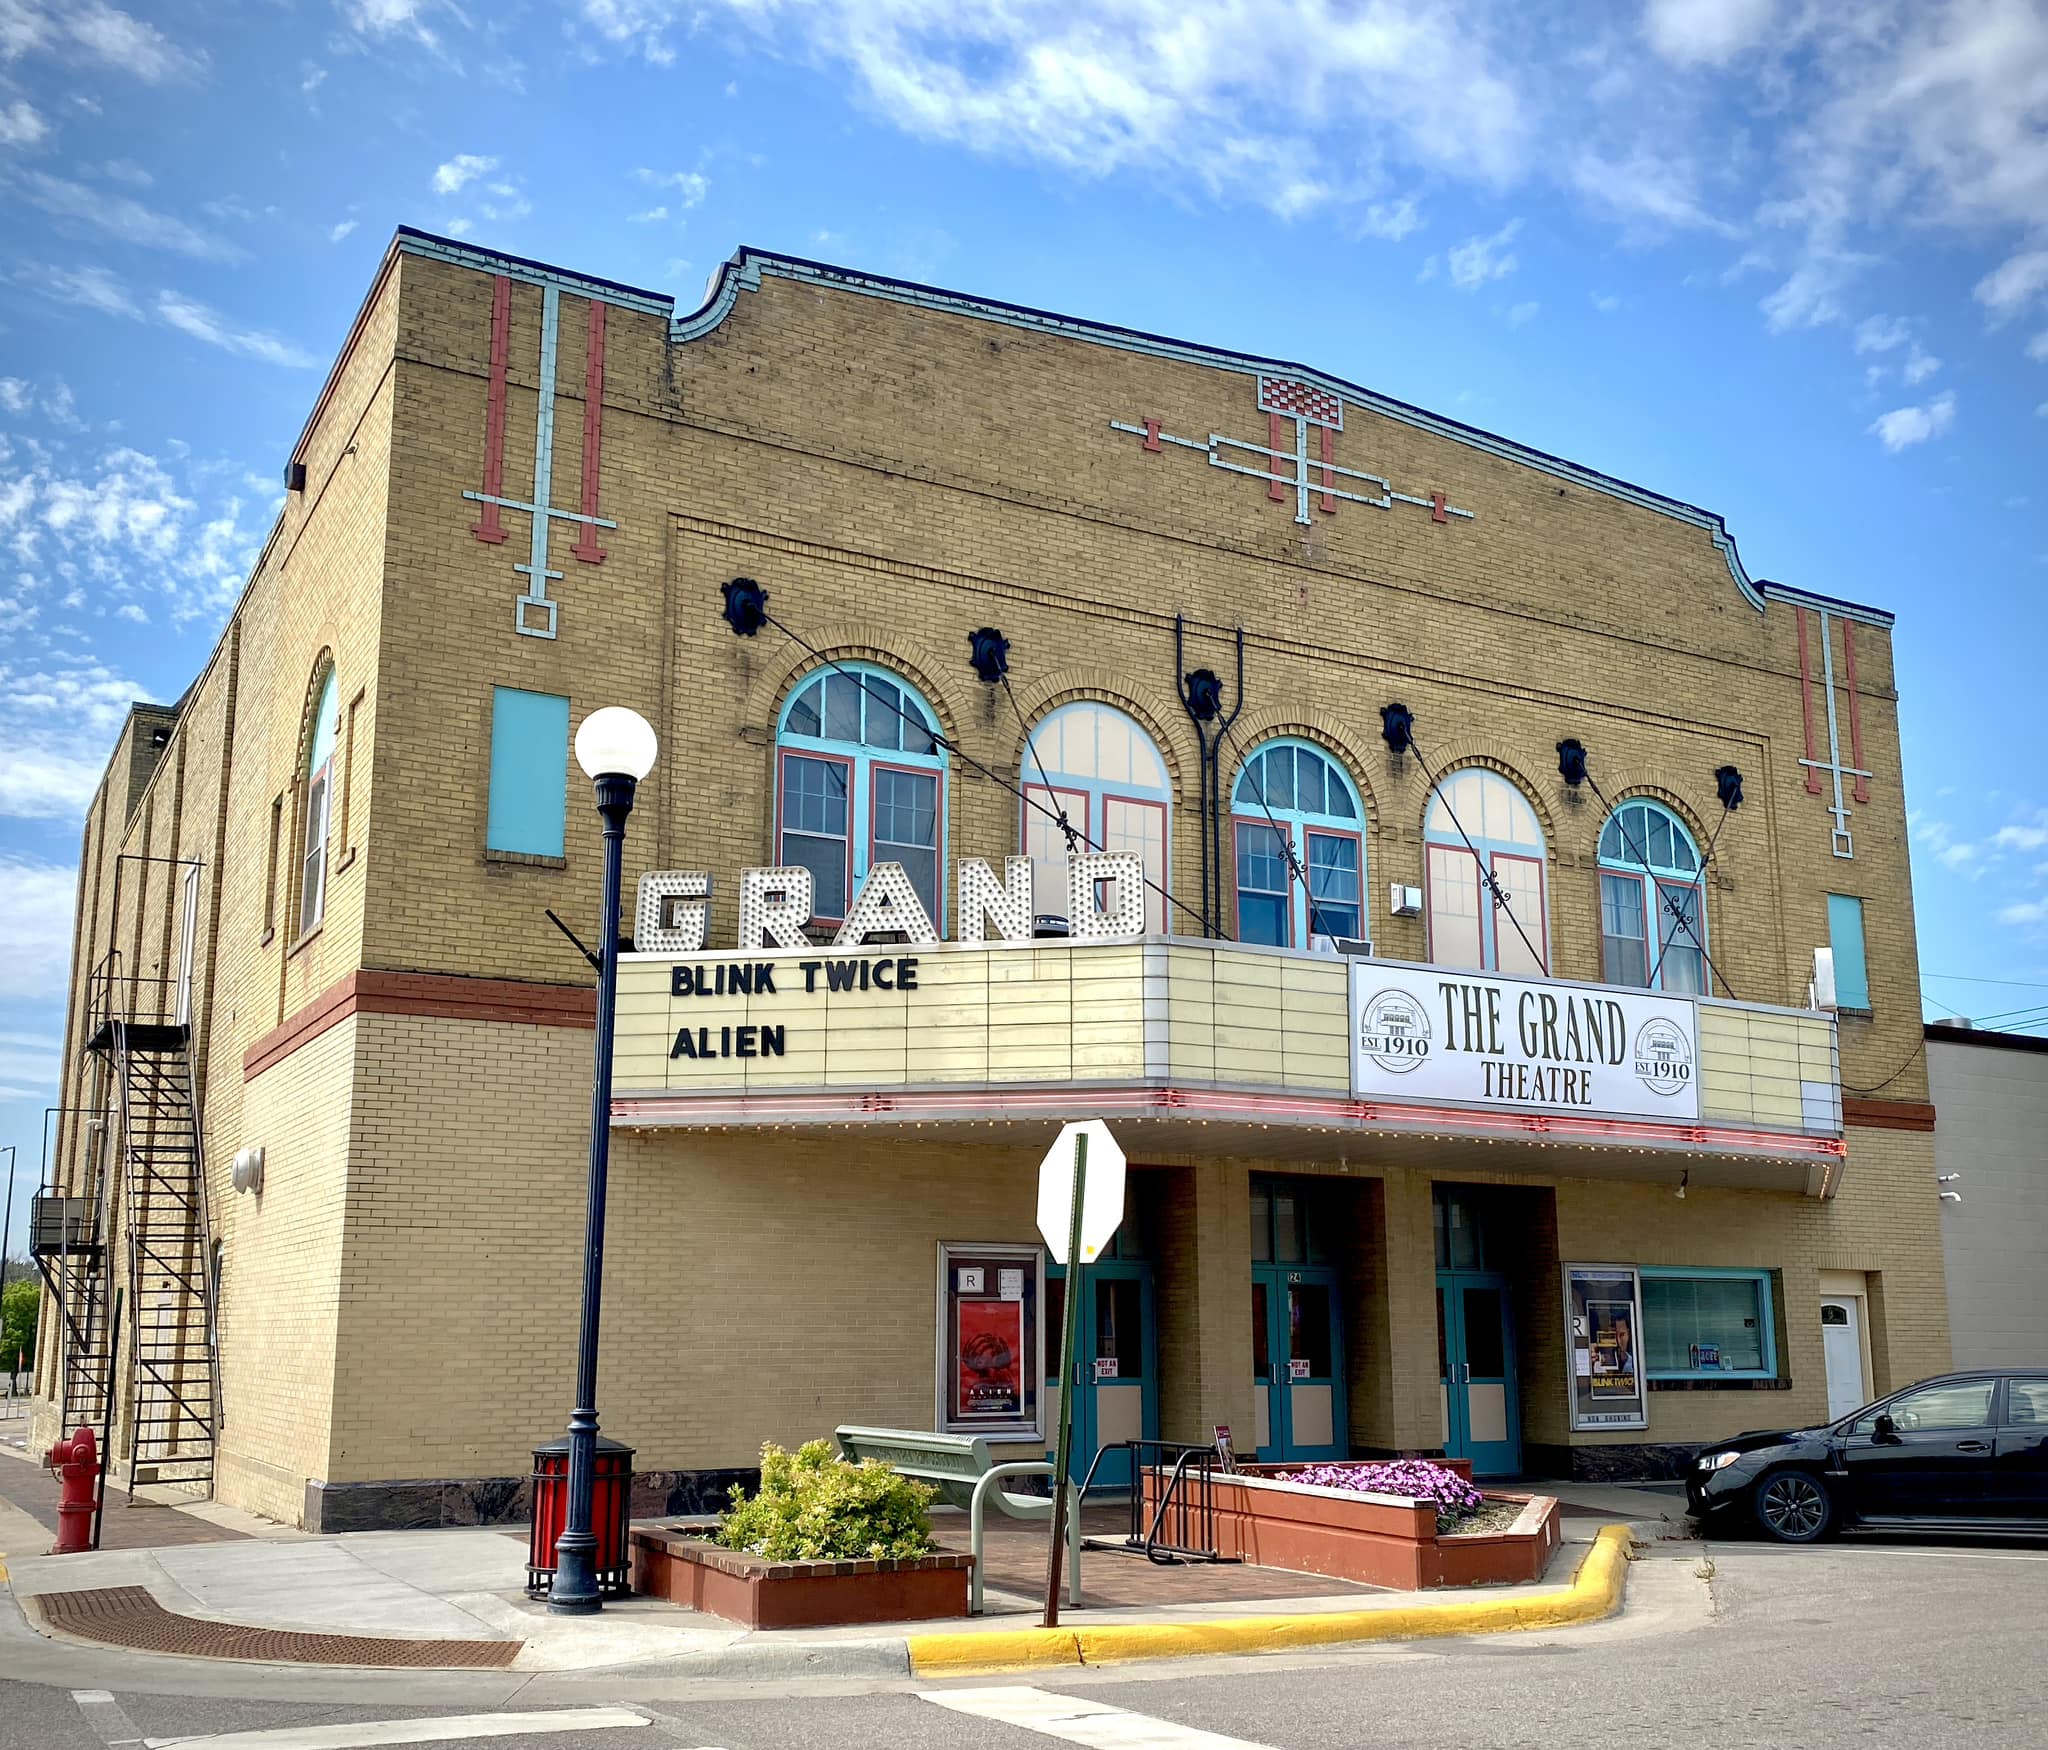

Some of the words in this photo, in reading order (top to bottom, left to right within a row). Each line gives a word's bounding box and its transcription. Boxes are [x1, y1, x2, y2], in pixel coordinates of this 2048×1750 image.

[633, 849, 1147, 953] GRAND
[671, 961, 777, 997] BLINK
[799, 957, 918, 993] TWICE
[1438, 981, 1505, 1055] THE
[1518, 990, 1627, 1066] GRAND
[670, 1024, 785, 1060] ALIEN
[1383, 1036, 1429, 1057] 1910
[1480, 1060, 1592, 1106] THEATRE
[1653, 1061, 1690, 1080] 1910
[966, 1275, 976, 1287] R
[1573, 1317, 1583, 1336] R
[1295, 1368, 1306, 1376] EXIT
